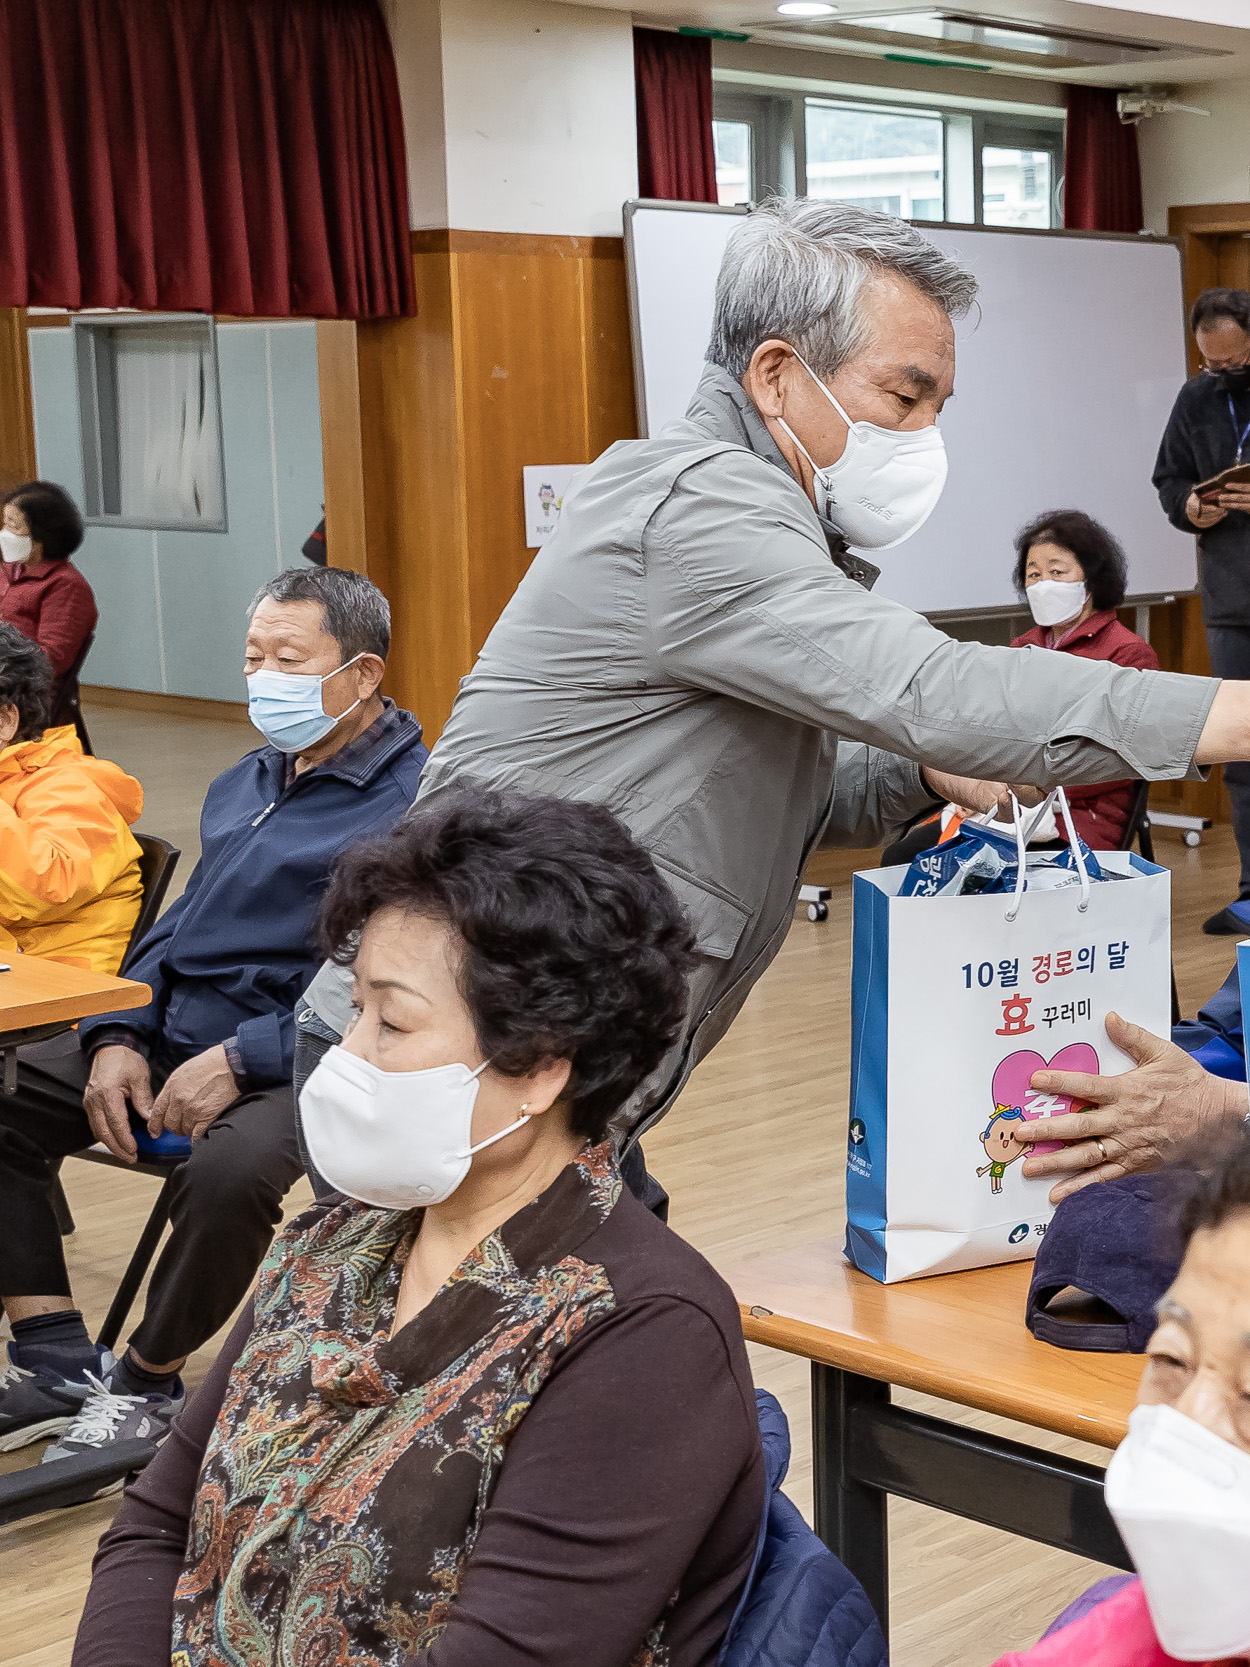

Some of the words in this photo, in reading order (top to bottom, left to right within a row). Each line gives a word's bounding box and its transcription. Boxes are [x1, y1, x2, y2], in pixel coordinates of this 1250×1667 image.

[961, 957, 1019, 989] 10월
[1031, 945, 1096, 984] 경로의
[1107, 941, 1130, 970] 달
[995, 993, 1035, 1036] 효
[1041, 998, 1091, 1029] 꾸러미
